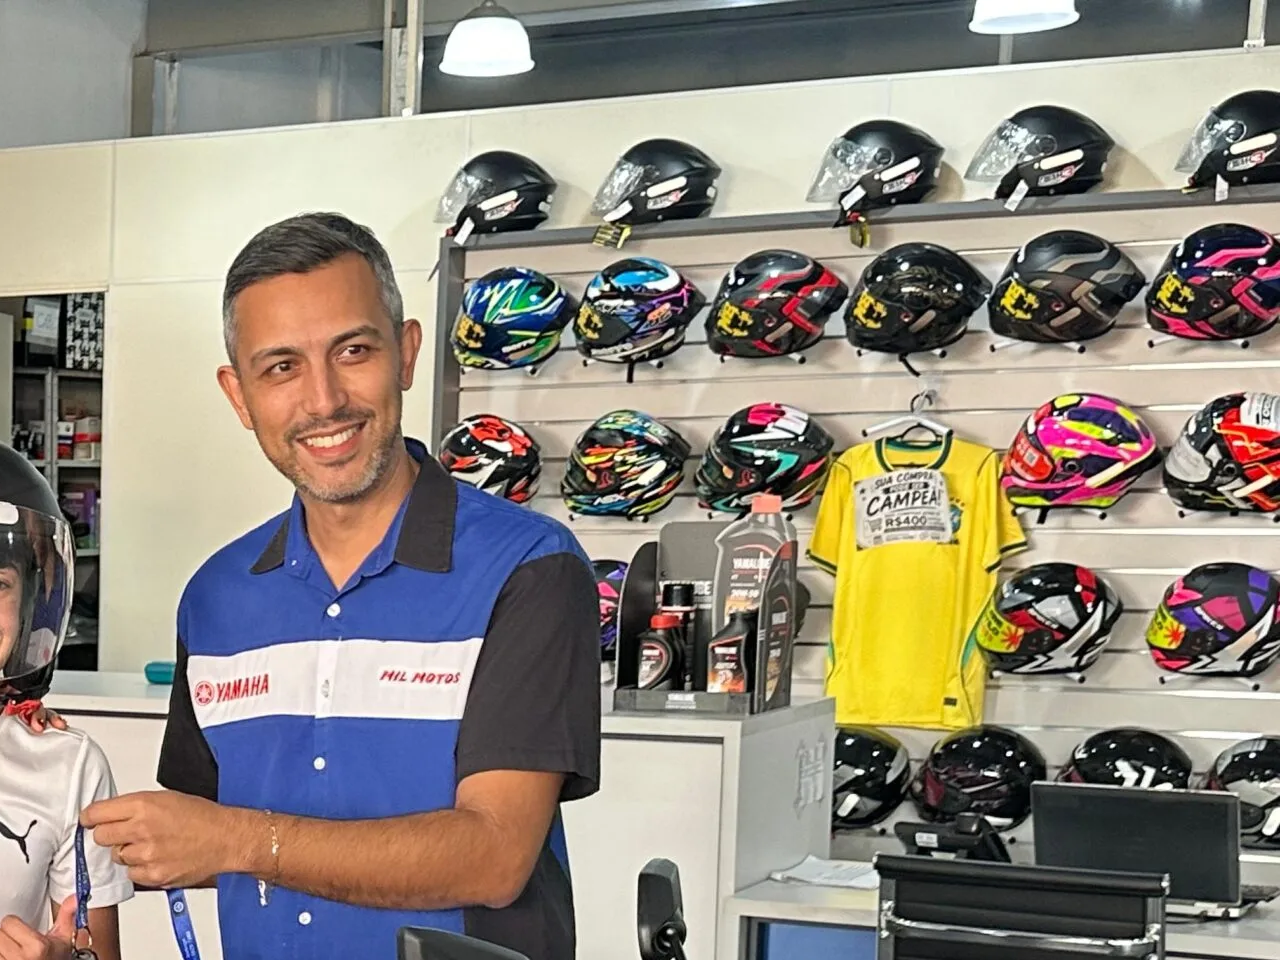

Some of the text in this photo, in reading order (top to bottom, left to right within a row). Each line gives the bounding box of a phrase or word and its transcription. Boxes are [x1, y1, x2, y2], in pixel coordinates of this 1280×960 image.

[216, 673, 270, 703] YAMAHA
[379, 669, 461, 685] MIL MOTOS
